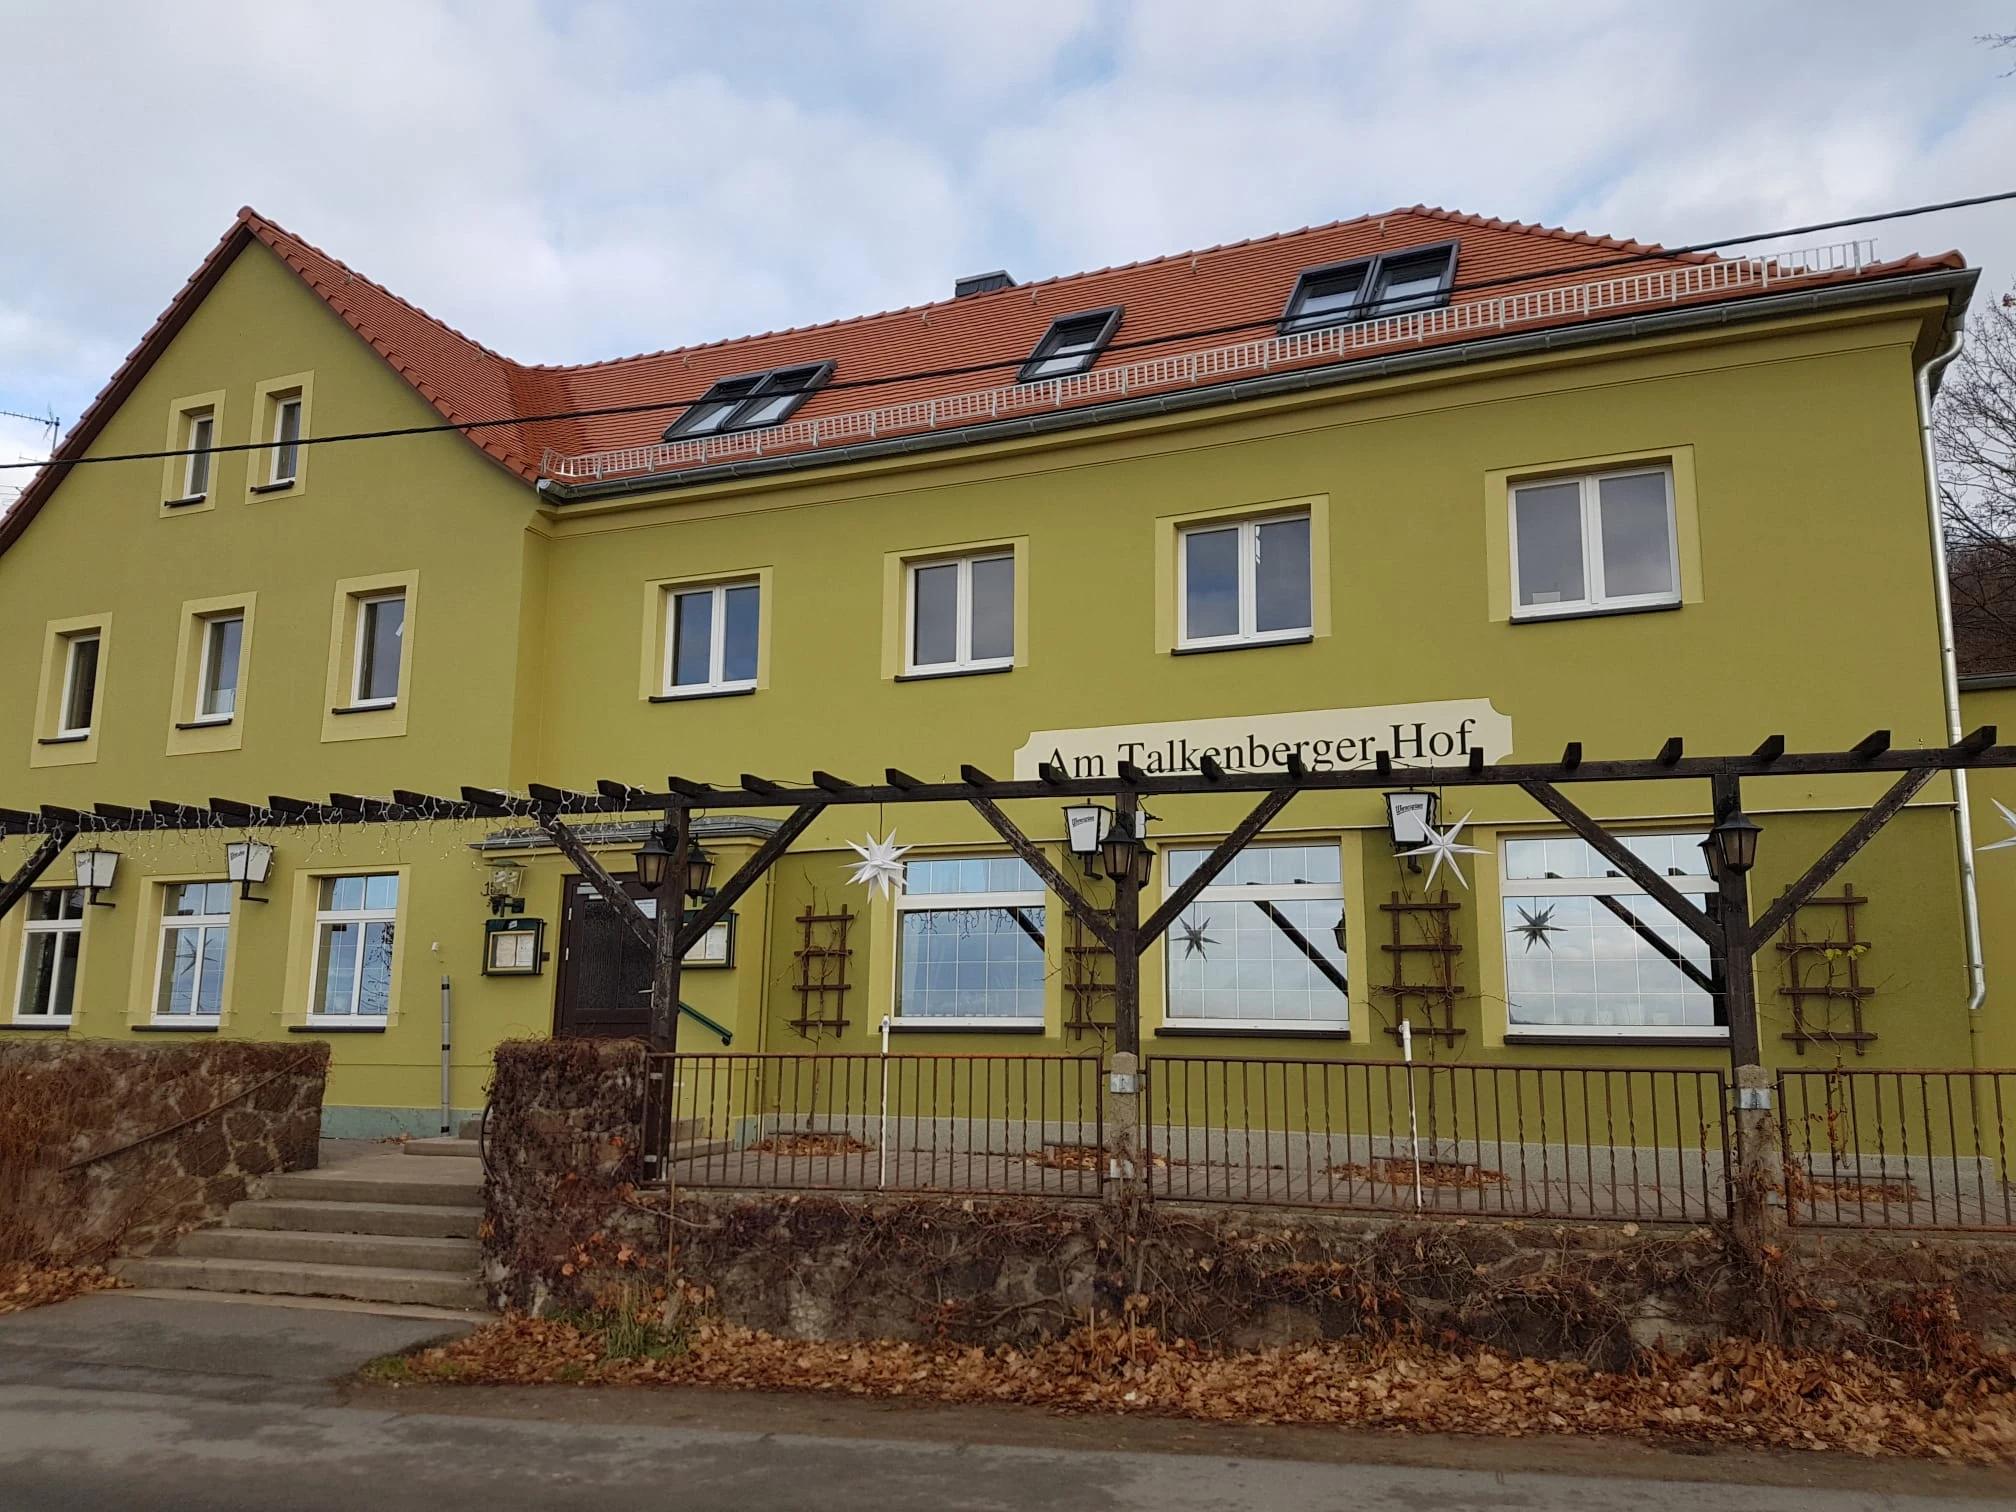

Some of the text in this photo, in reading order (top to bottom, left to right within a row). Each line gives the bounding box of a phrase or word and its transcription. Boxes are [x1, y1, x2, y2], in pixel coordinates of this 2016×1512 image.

[1047, 718, 1476, 778] Am Talkenberger Hof
